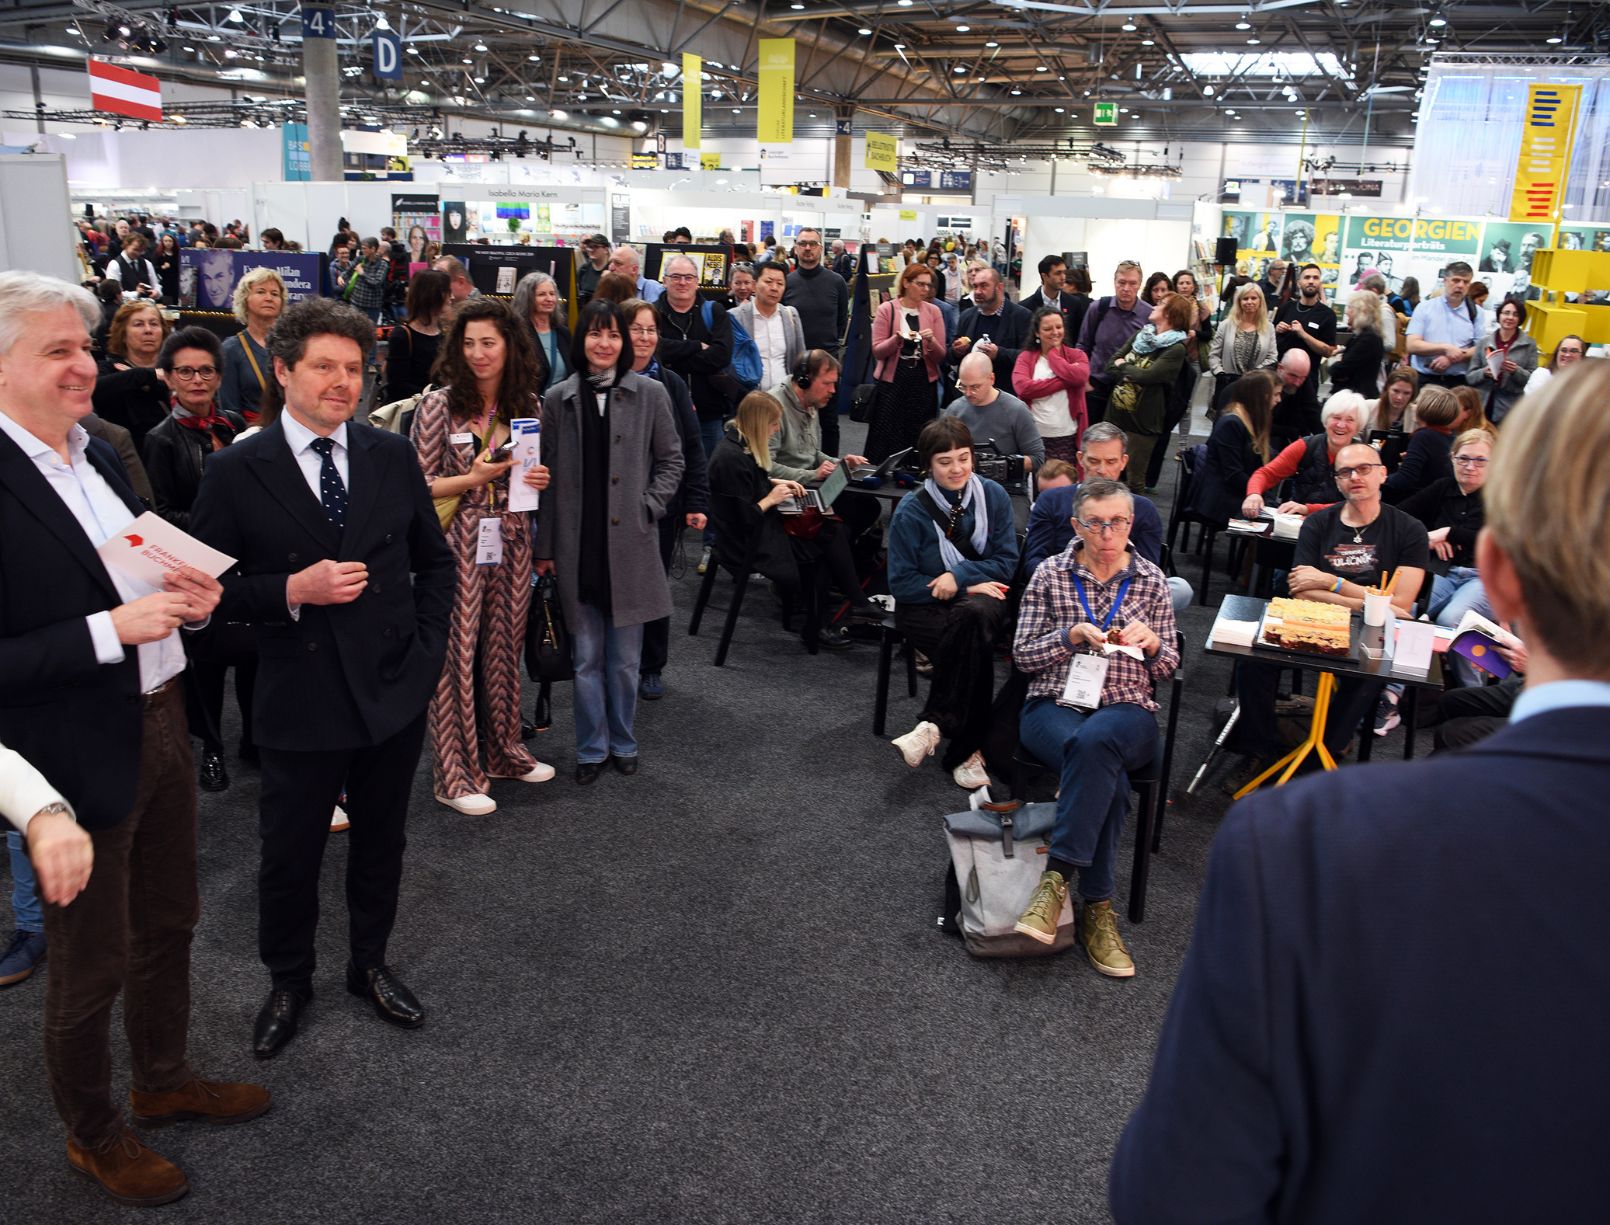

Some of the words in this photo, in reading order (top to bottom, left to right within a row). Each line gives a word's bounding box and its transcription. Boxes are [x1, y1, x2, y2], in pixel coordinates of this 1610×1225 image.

[310, 11, 325, 35] 4
[377, 36, 397, 73] D
[843, 121, 851, 134] 4
[657, 134, 665, 152] B
[518, 190, 540, 199] Maria
[1363, 218, 1480, 241] GEORGIEN
